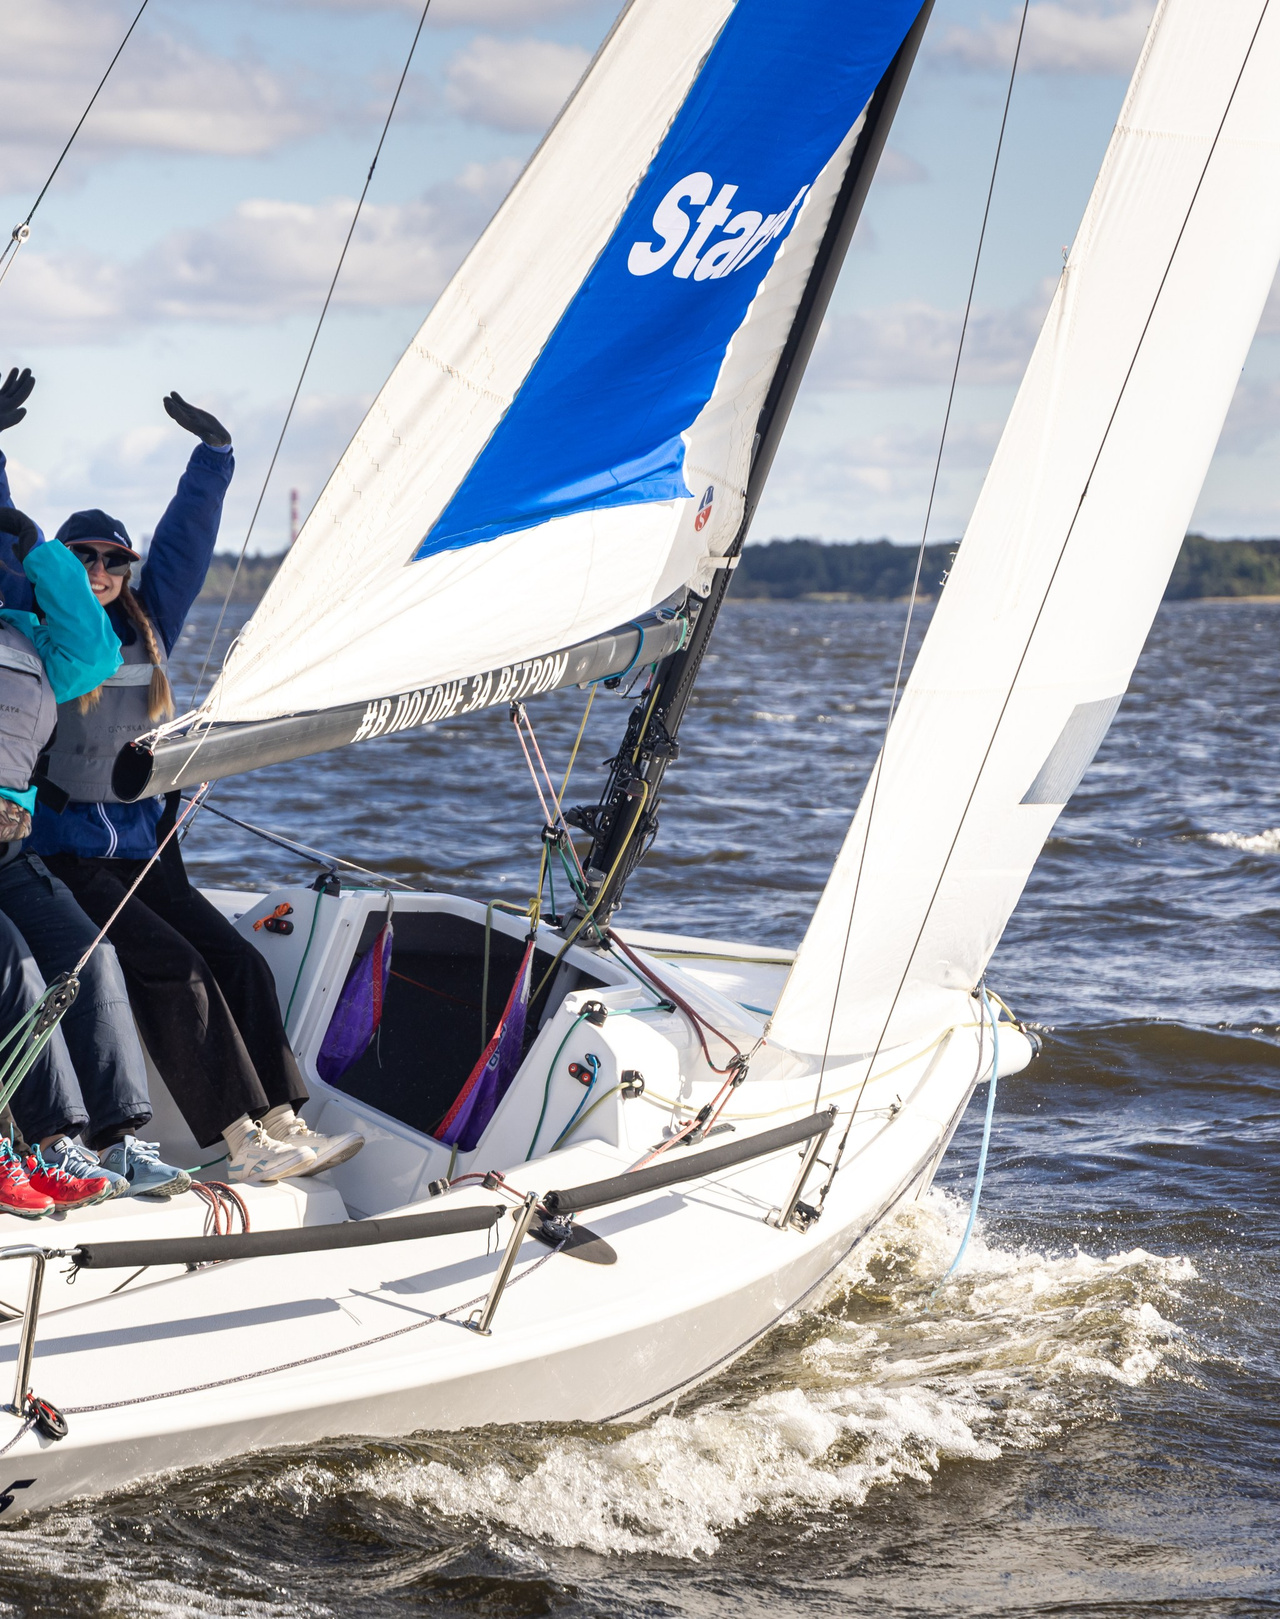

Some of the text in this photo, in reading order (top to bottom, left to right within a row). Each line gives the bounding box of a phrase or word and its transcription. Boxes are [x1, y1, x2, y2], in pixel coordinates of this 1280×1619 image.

[386, 678, 468, 733] ПОГОНЕ
[462, 670, 494, 712] ЗА
[489, 653, 569, 703] ВЕТРОМ
